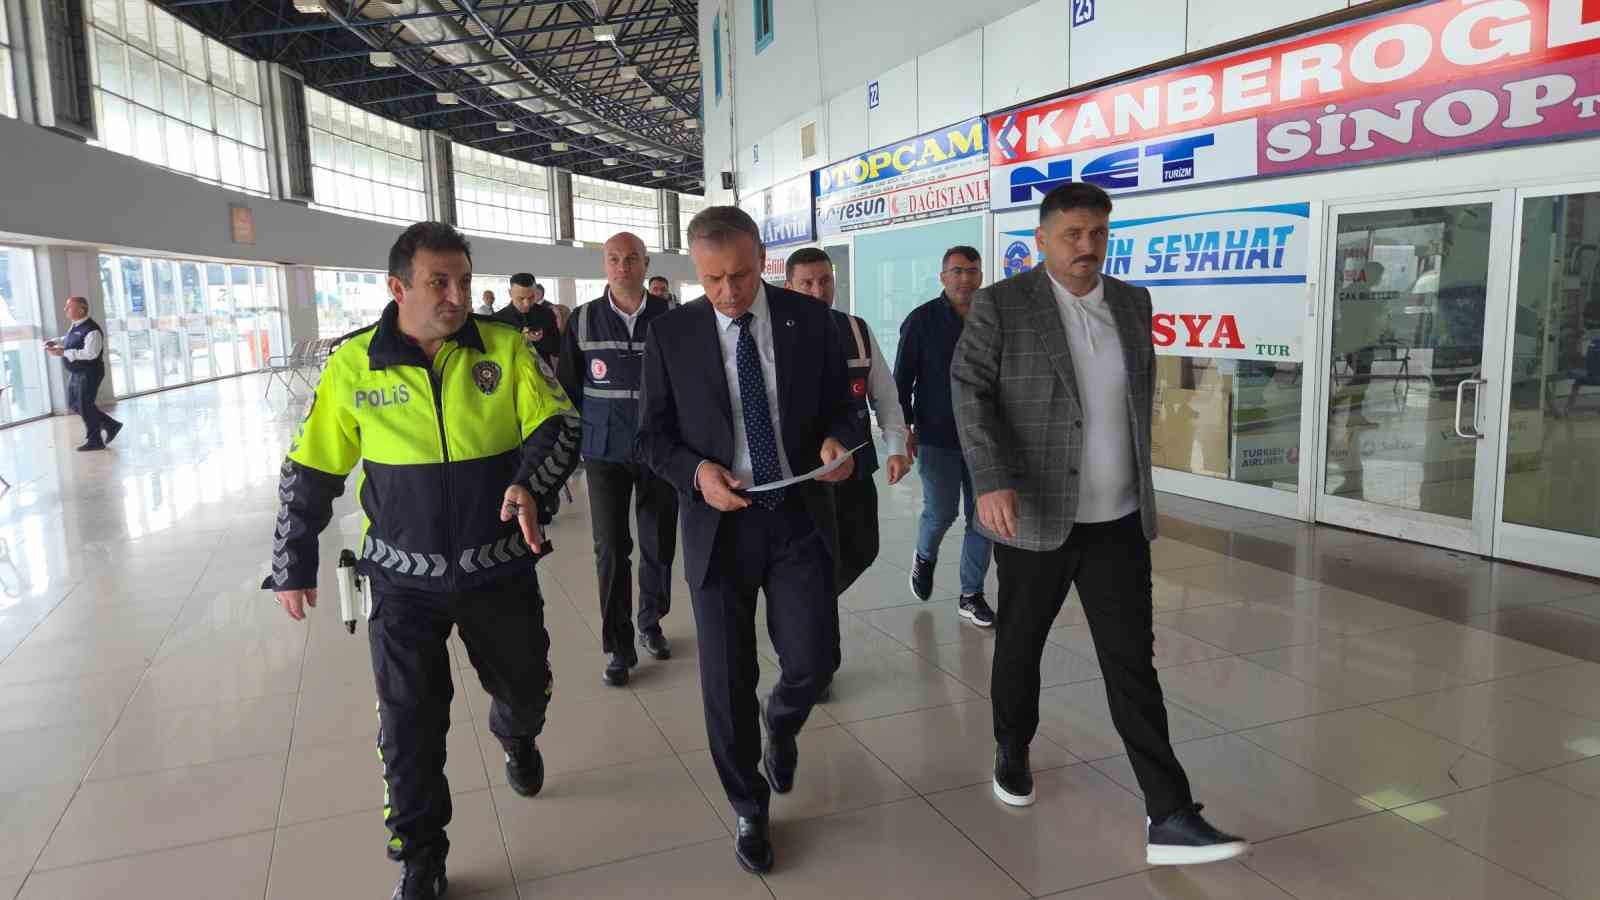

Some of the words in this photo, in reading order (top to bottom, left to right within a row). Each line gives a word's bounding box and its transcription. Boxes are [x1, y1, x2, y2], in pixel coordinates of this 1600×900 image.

[1266, 73, 1577, 163] SİNOP
[1010, 132, 1215, 203] NET
[1164, 166, 1193, 180] TURİZM
[1144, 225, 1295, 274] SEYAHAT
[1152, 313, 1246, 350] SYA
[1256, 344, 1291, 357] TUR
[355, 384, 411, 408] POLİS
